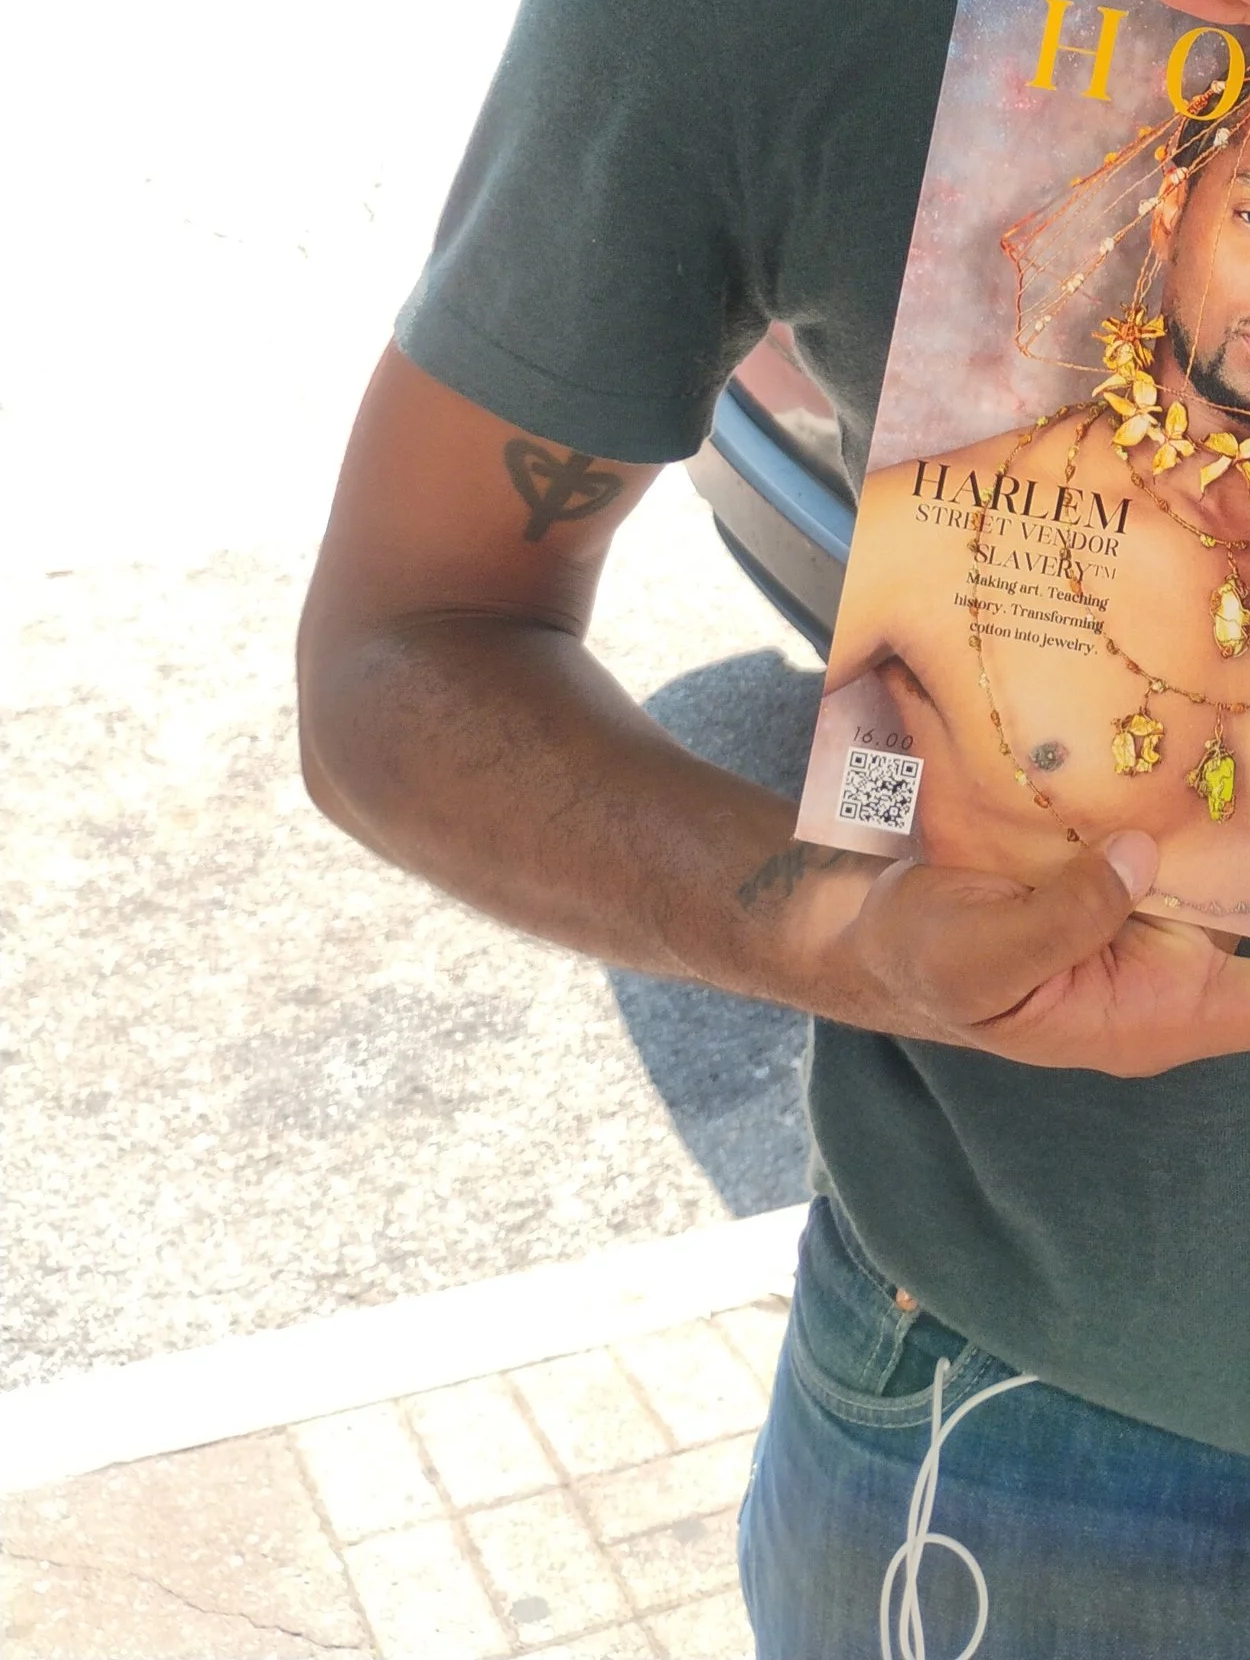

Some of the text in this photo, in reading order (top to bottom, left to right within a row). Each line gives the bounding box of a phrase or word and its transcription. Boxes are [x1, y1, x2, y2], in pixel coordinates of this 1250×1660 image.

[912, 459, 1133, 535] HARLEM
[915, 503, 1120, 558] STREET VENDOR
[966, 571, 1110, 613] Making art. Teaching
[953, 592, 1105, 636] history. Transforming
[969, 621, 1099, 656] cotton into jewelry.
[853, 726, 914, 751] 16.00
